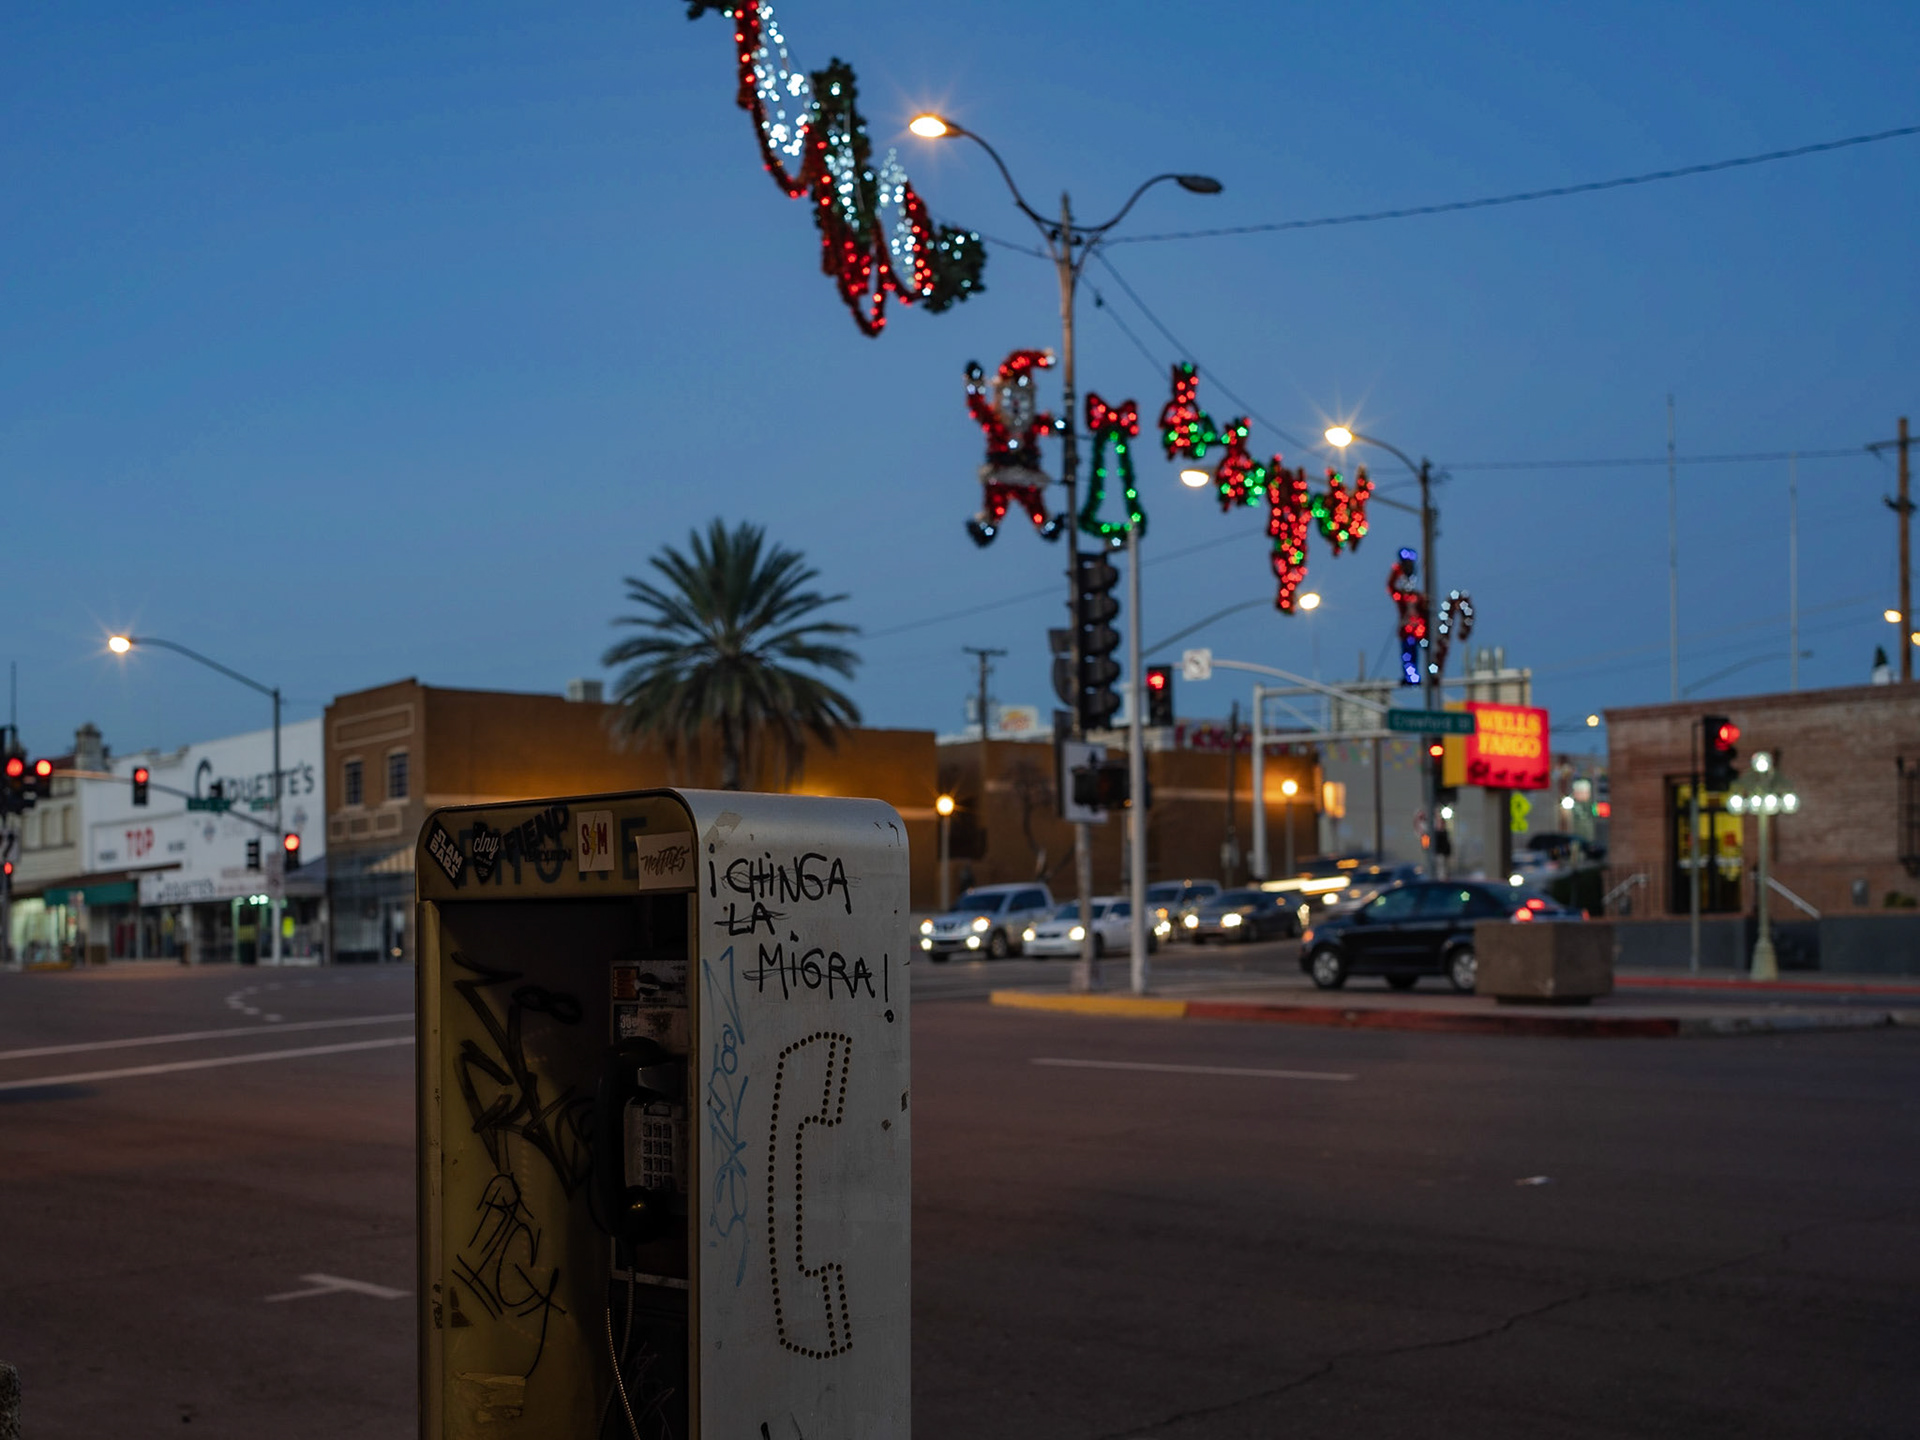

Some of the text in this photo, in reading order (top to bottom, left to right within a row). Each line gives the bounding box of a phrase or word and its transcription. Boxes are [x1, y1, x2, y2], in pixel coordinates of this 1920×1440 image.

[1474, 708, 1542, 736] WELLS
[1476, 731, 1542, 759] FARGO
[429, 837, 459, 879] BARS
[434, 829, 463, 869] SLAM
[727, 902, 777, 936] LA
